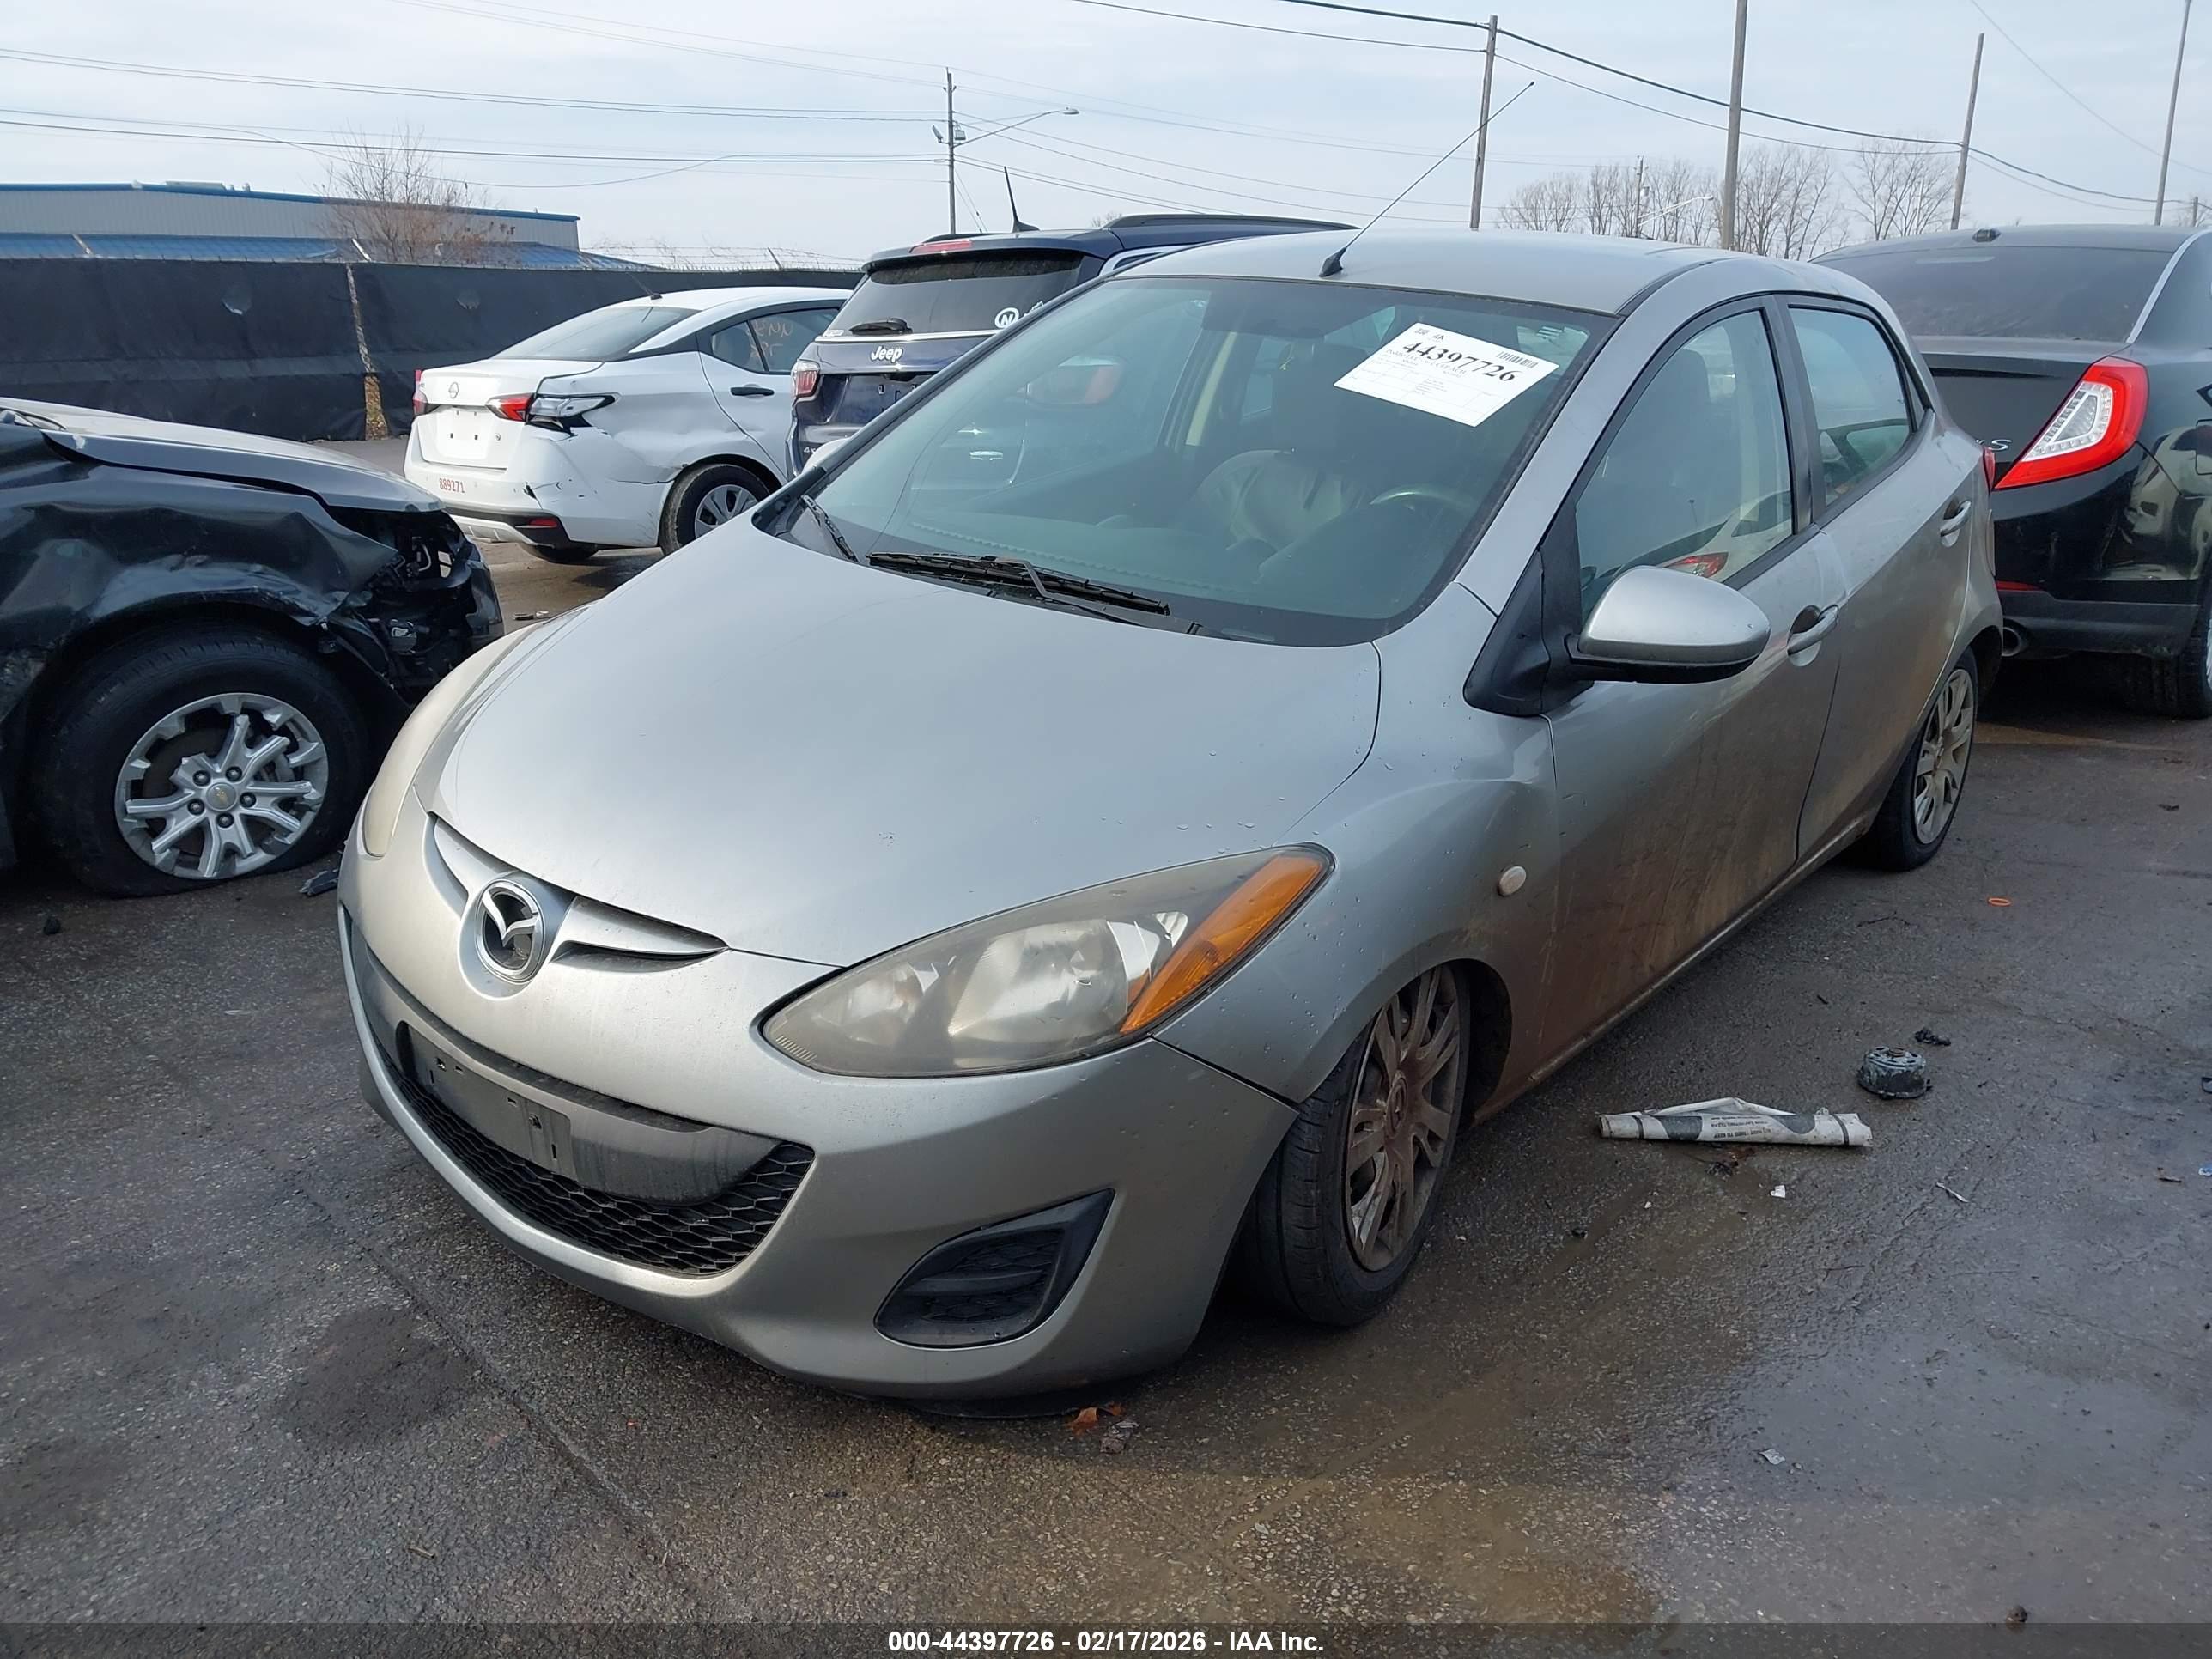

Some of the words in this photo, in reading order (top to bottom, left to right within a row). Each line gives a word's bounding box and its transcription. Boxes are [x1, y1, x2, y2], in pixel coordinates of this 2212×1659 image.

[871, 345, 902, 362] Jeep
[1403, 342, 1522, 381] 44397726
[439, 477, 465, 494] 889271
